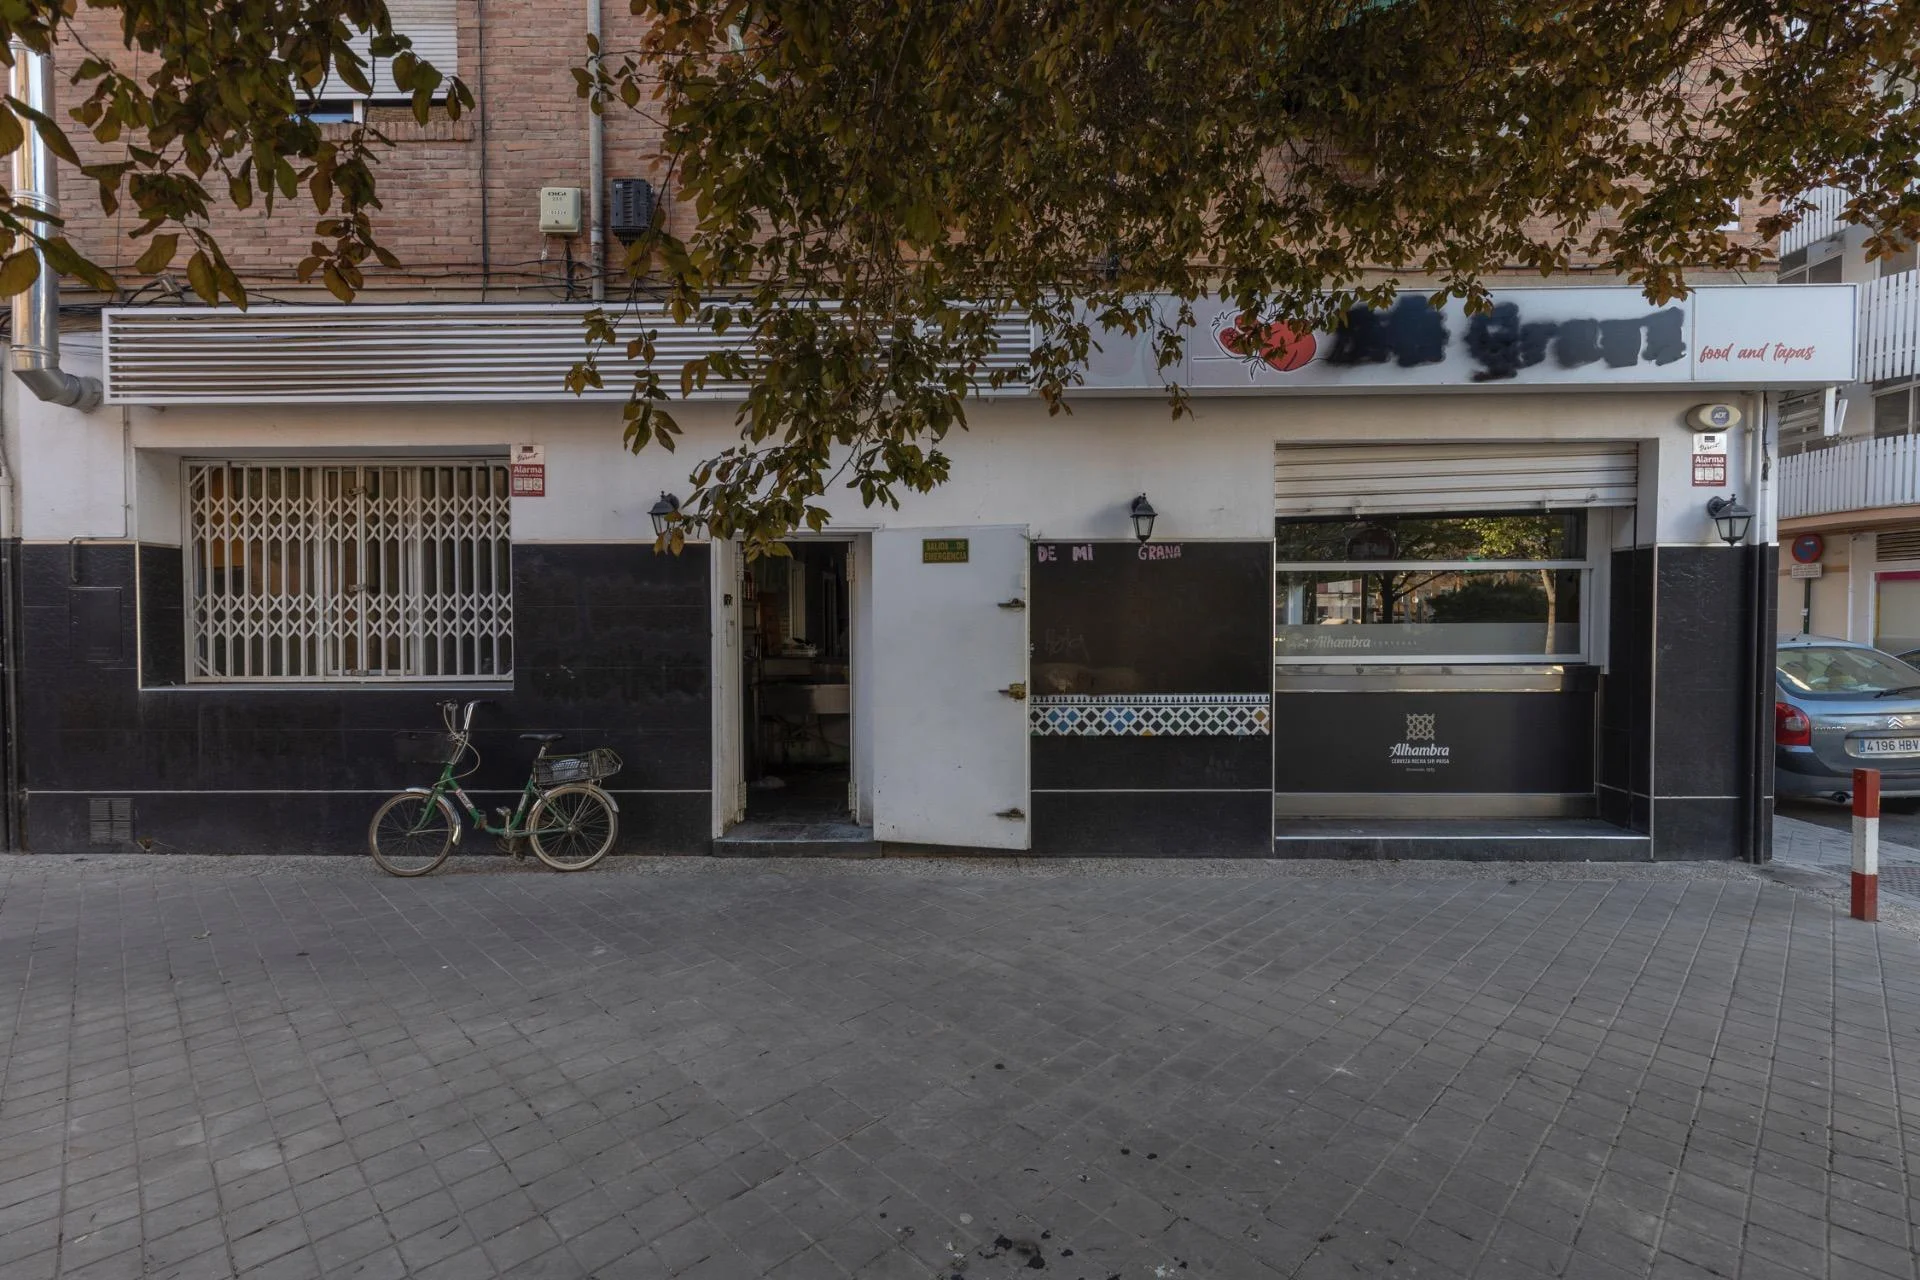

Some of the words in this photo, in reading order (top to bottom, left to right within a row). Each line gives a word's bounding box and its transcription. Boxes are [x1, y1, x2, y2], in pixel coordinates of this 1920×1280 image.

[1699, 343, 1734, 363] food
[1738, 343, 1769, 361] and
[1773, 342, 1815, 364] tapas
[1695, 455, 1725, 464] Alarma
[513, 465, 543, 474] Alarma
[1038, 545, 1057, 562] DE
[1312, 634, 1371, 649] Alhambra
[1389, 743, 1450, 757] Alhambra
[1867, 740, 1895, 752] 4196
[1898, 739, 1919, 751] HBV
